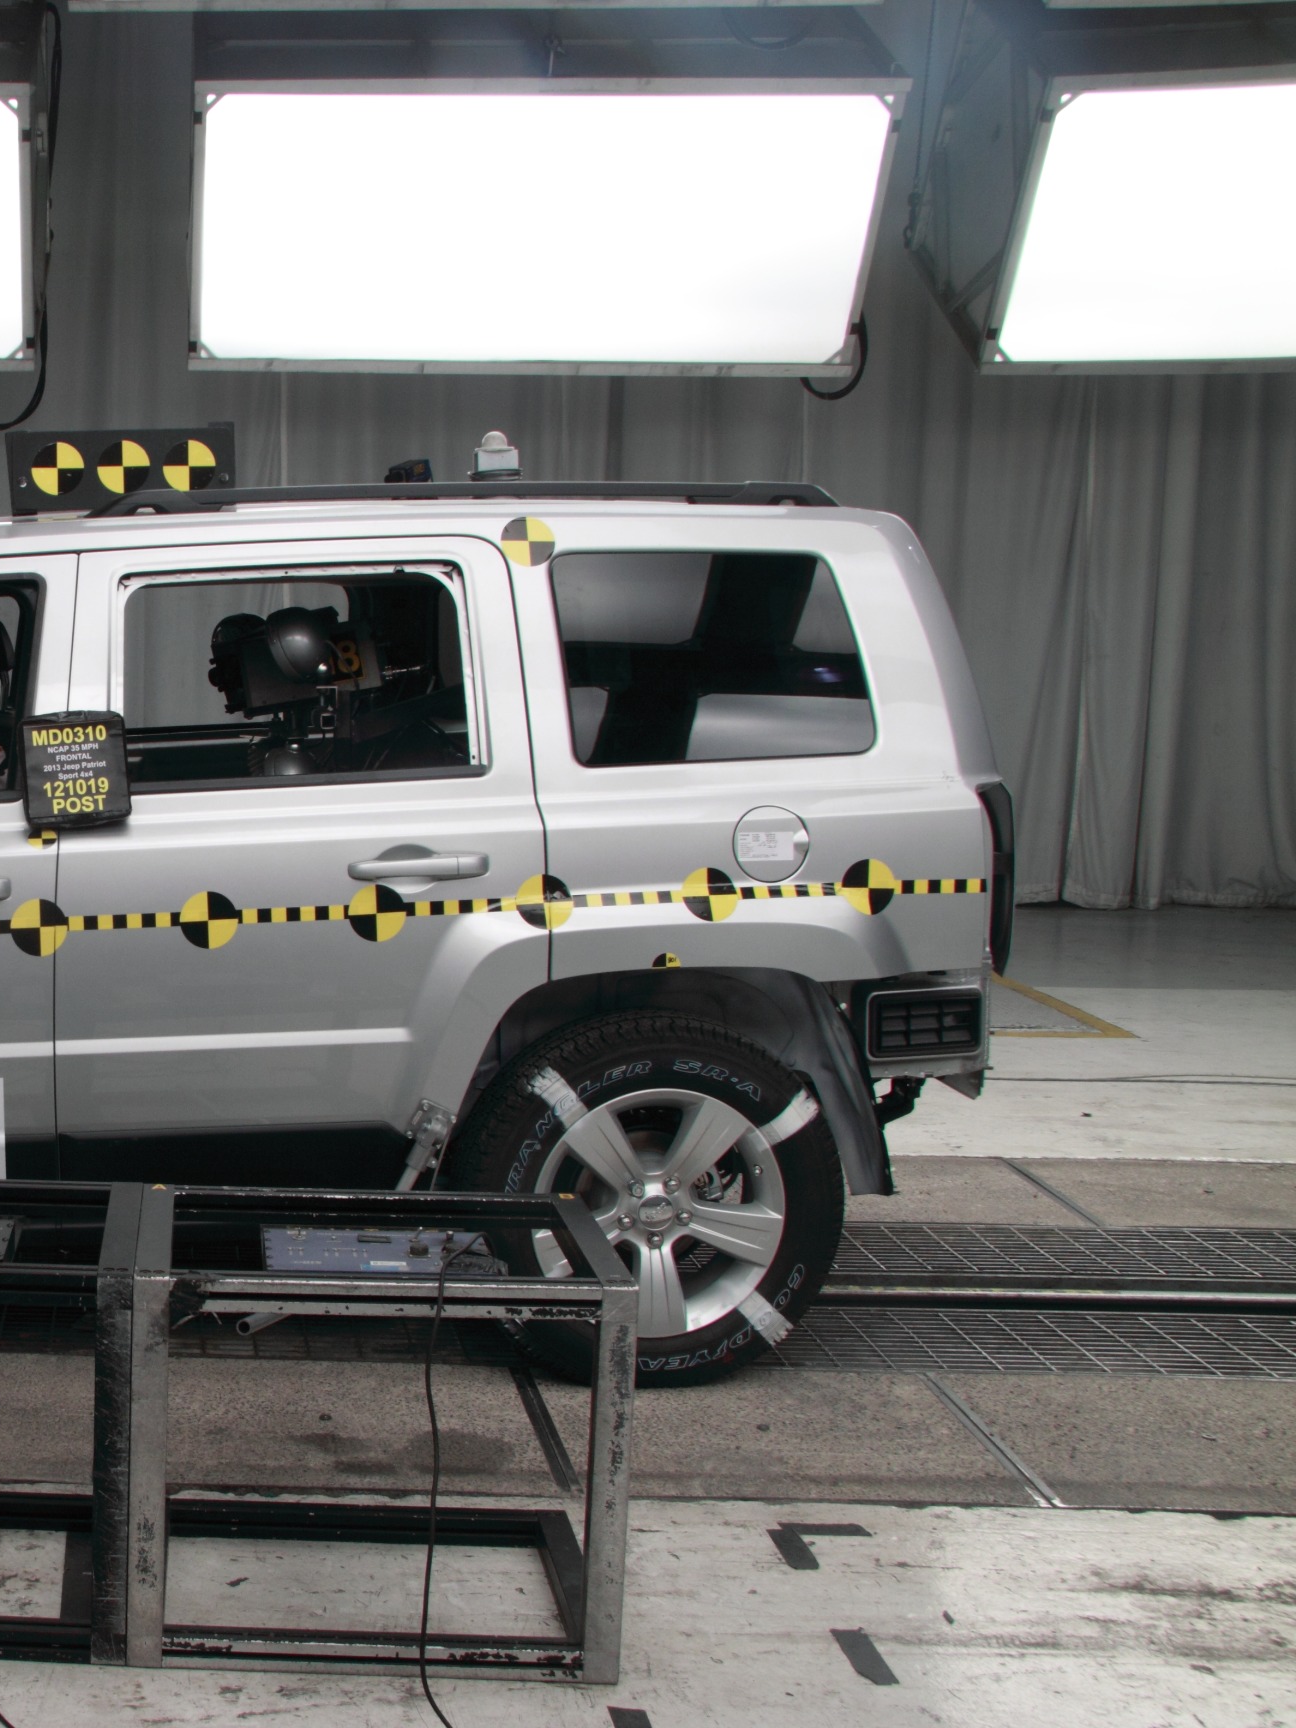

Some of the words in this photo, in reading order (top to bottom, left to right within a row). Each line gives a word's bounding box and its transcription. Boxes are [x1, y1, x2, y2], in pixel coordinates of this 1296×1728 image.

[31, 725, 107, 746] MD0310
[47, 745, 69, 754] NCAP
[71, 744, 80, 752] 35
[81, 743, 99, 751] MPH
[56, 753, 92, 762] FRONTAL
[43, 763, 61, 772] 2013
[62, 762, 80, 773] Jeep
[81, 761, 106, 770] Patriot
[58, 772, 79, 780] Sport
[80, 770, 94, 779] 4x4
[43, 777, 109, 798] 121019
[52, 794, 107, 814] POST
[504, 1060, 653, 1195] RANGLER
[637, 1263, 805, 1371] GOODYEA
